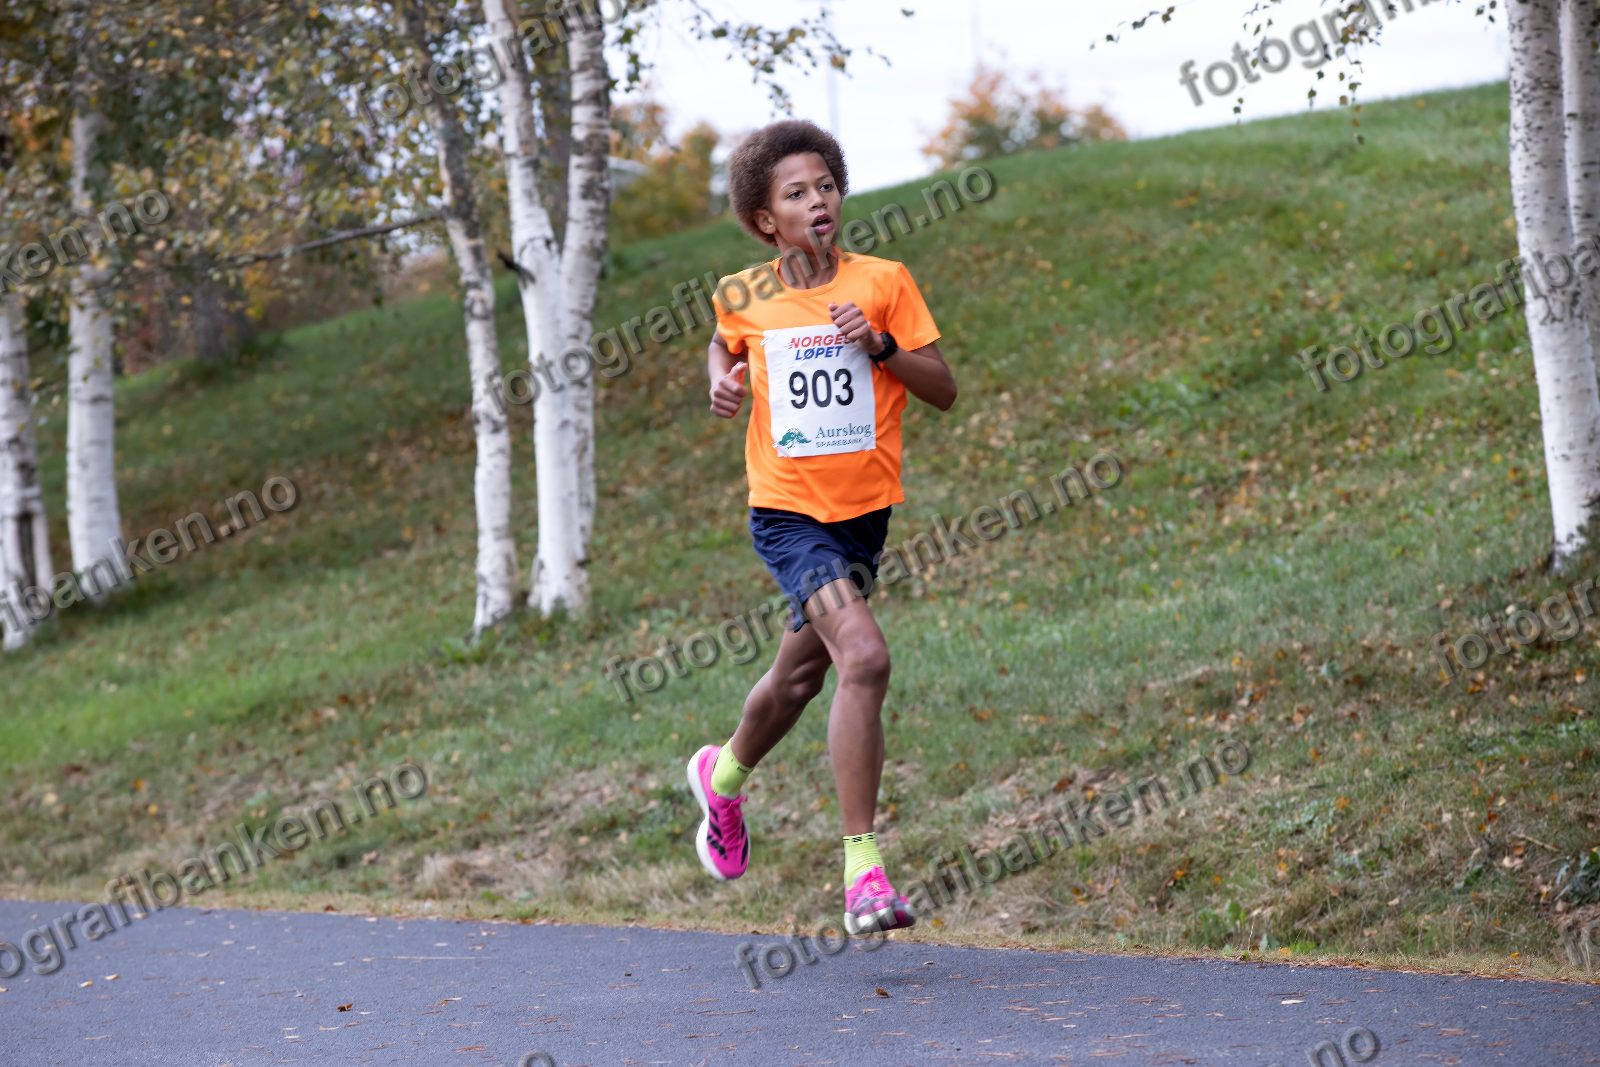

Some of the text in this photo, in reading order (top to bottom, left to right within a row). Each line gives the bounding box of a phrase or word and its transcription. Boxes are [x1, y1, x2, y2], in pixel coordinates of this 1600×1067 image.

[795, 346, 843, 360] LØPET
[789, 368, 854, 409] 903
[815, 422, 872, 438] Aurskog
[815, 437, 863, 448] SPAREBANK
